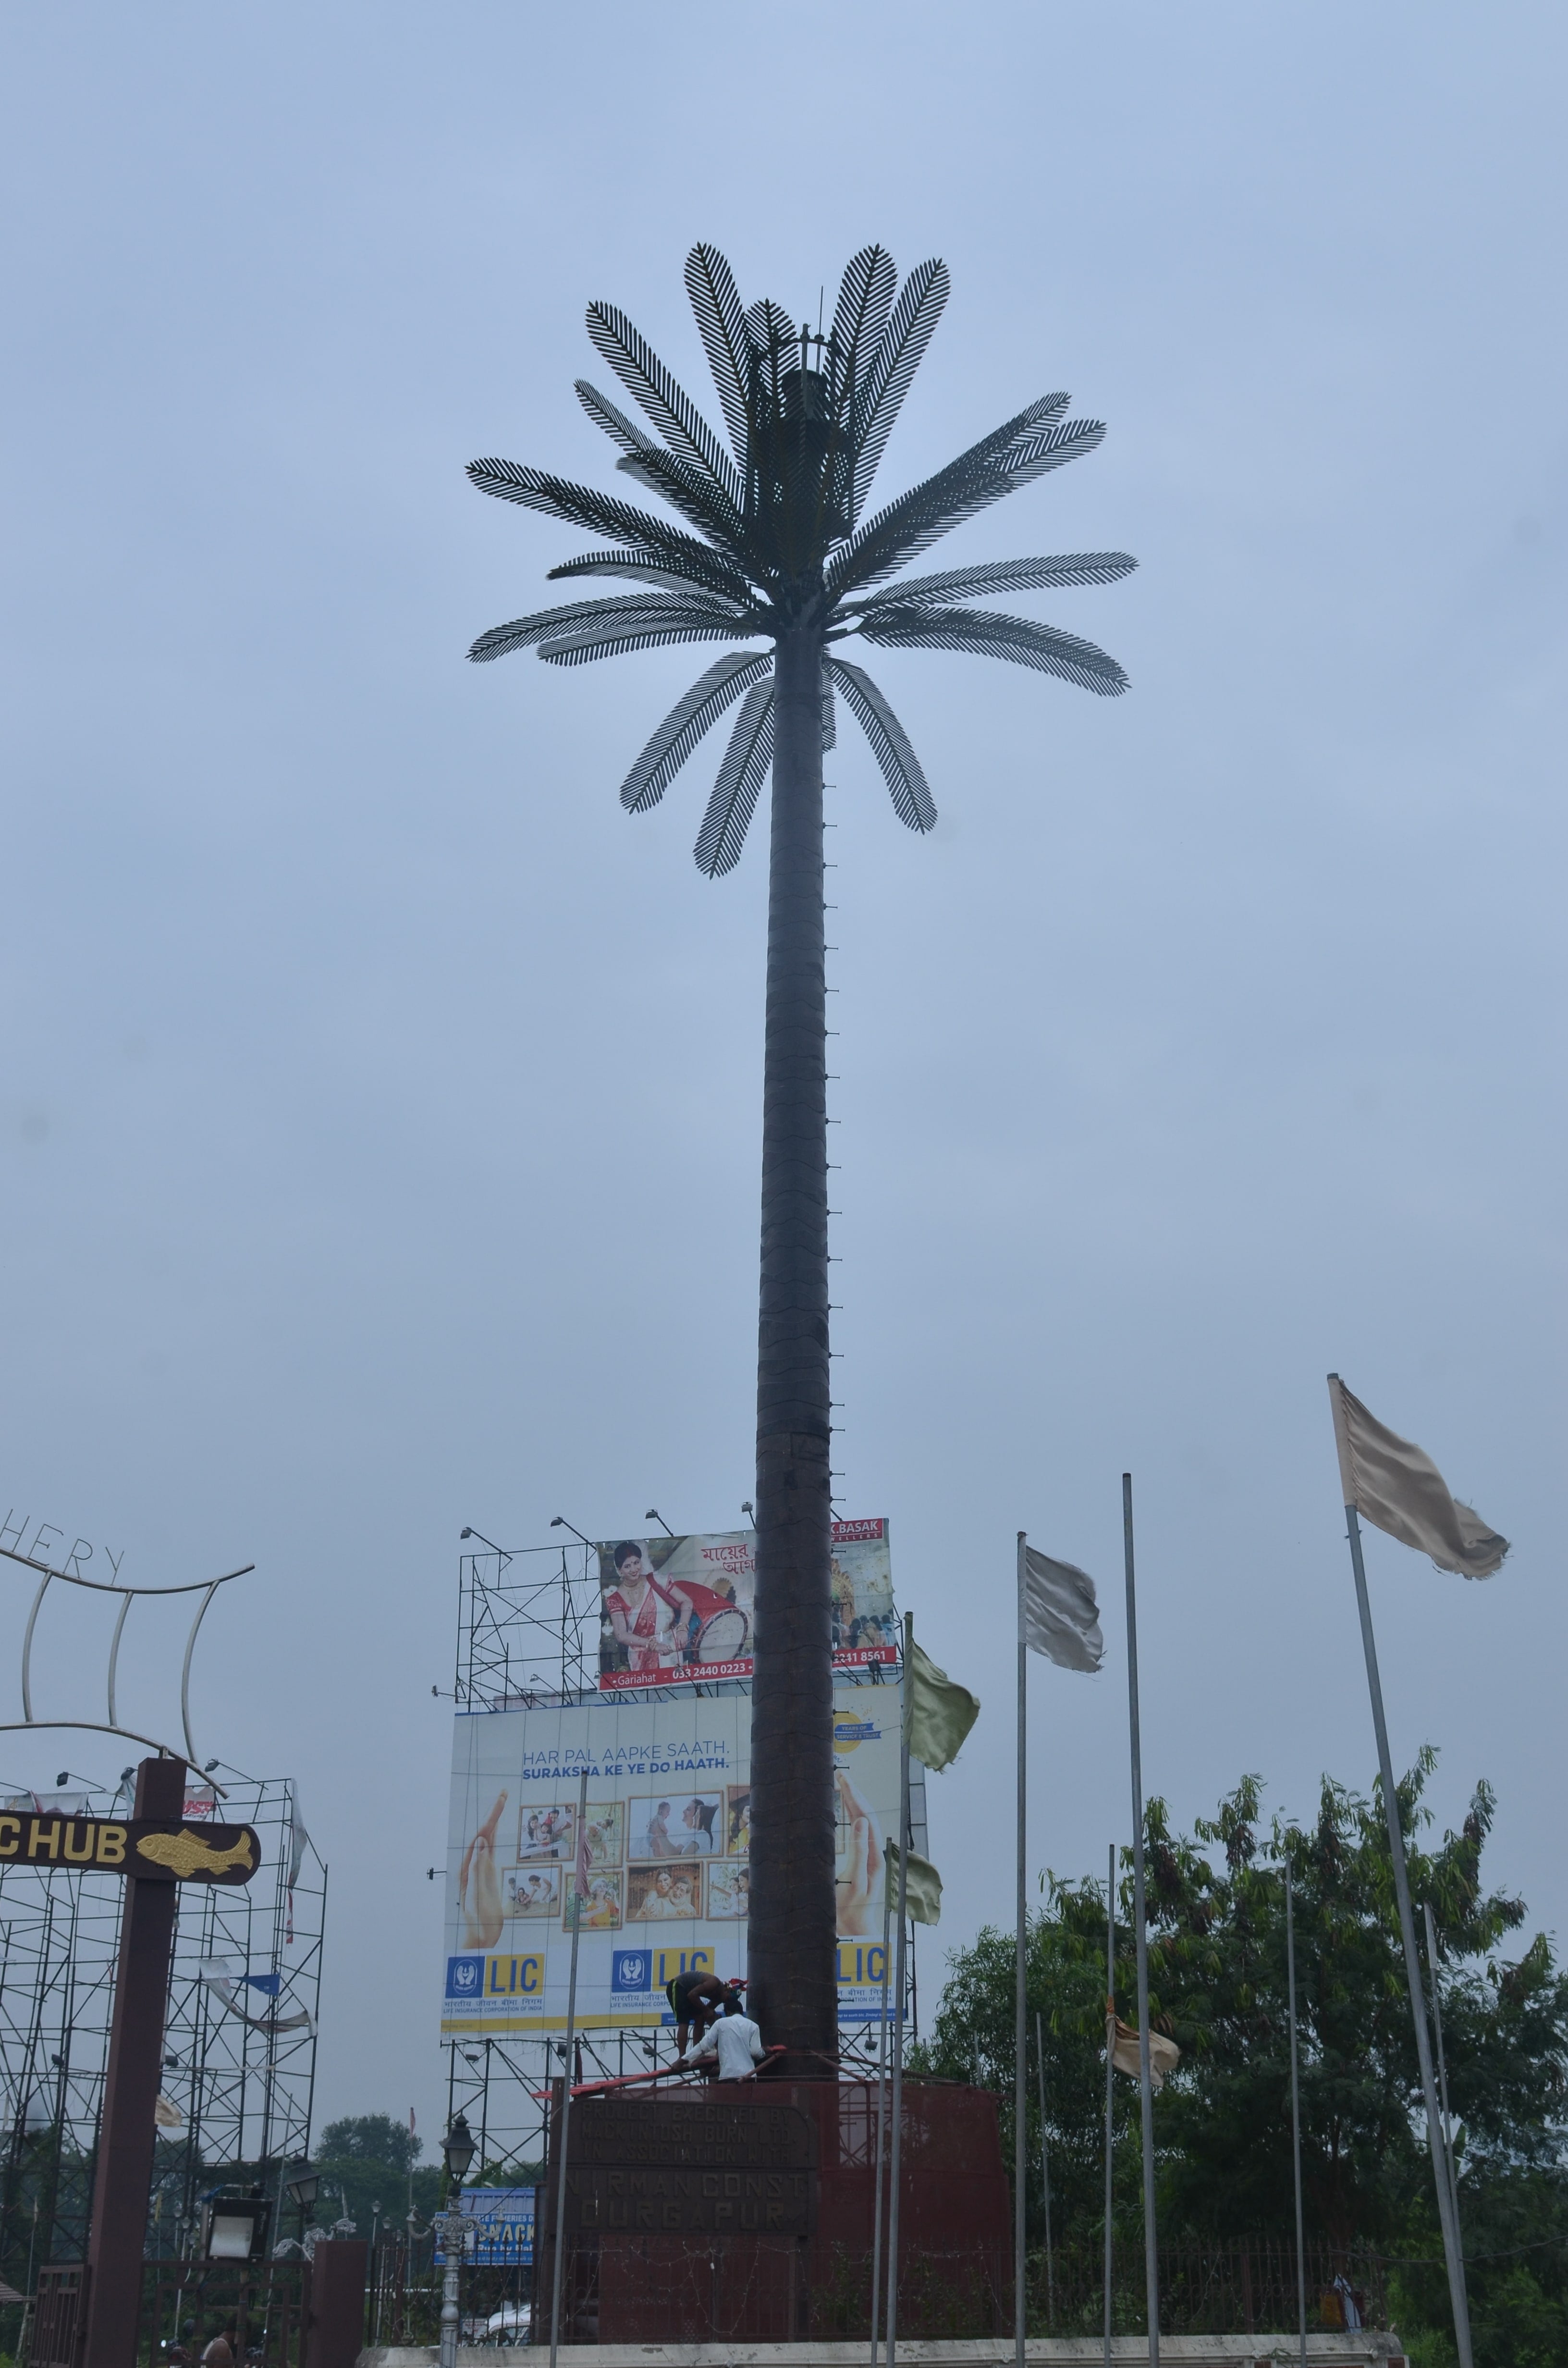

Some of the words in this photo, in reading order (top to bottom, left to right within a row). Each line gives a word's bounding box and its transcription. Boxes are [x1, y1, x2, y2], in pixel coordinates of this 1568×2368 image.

[860, 1651, 885, 1661] 8561
[618, 1674, 656, 1685] Gariahat
[673, 1670, 691, 1679] 033
[694, 1666, 718, 1677] 2440
[720, 1663, 745, 1674] 0223
[523, 1751, 558, 1765] HAR
[565, 1749, 596, 1763] PAL
[602, 1745, 661, 1762] AAPKE
[667, 1741, 730, 1757] SAATH.
[523, 1766, 600, 1779] SURAKSHA
[605, 1764, 623, 1776] KE
[627, 1763, 645, 1775] YE
[649, 1762, 670, 1773] DO
[674, 1758, 729, 1771] HAATH.
[490, 1958, 538, 1993] LIC
[837, 1948, 884, 1982] LIC
[611, 1993, 639, 2001] भारतीय
[644, 1993, 665, 2001] जीवन
[582, 2103, 658, 2121] PROJECT
[672, 2105, 758, 2123] EXECUTED
[771, 2108, 789, 2124] BY
[582, 2122, 692, 2142] MACKINTOSH
[705, 2126, 747, 2143] BURN
[583, 2143, 602, 2160] IN
[616, 2144, 735, 2162] ASSOCIATION
[748, 2147, 791, 2164] WITH
[581, 2200, 784, 2231] DURGAPUR
